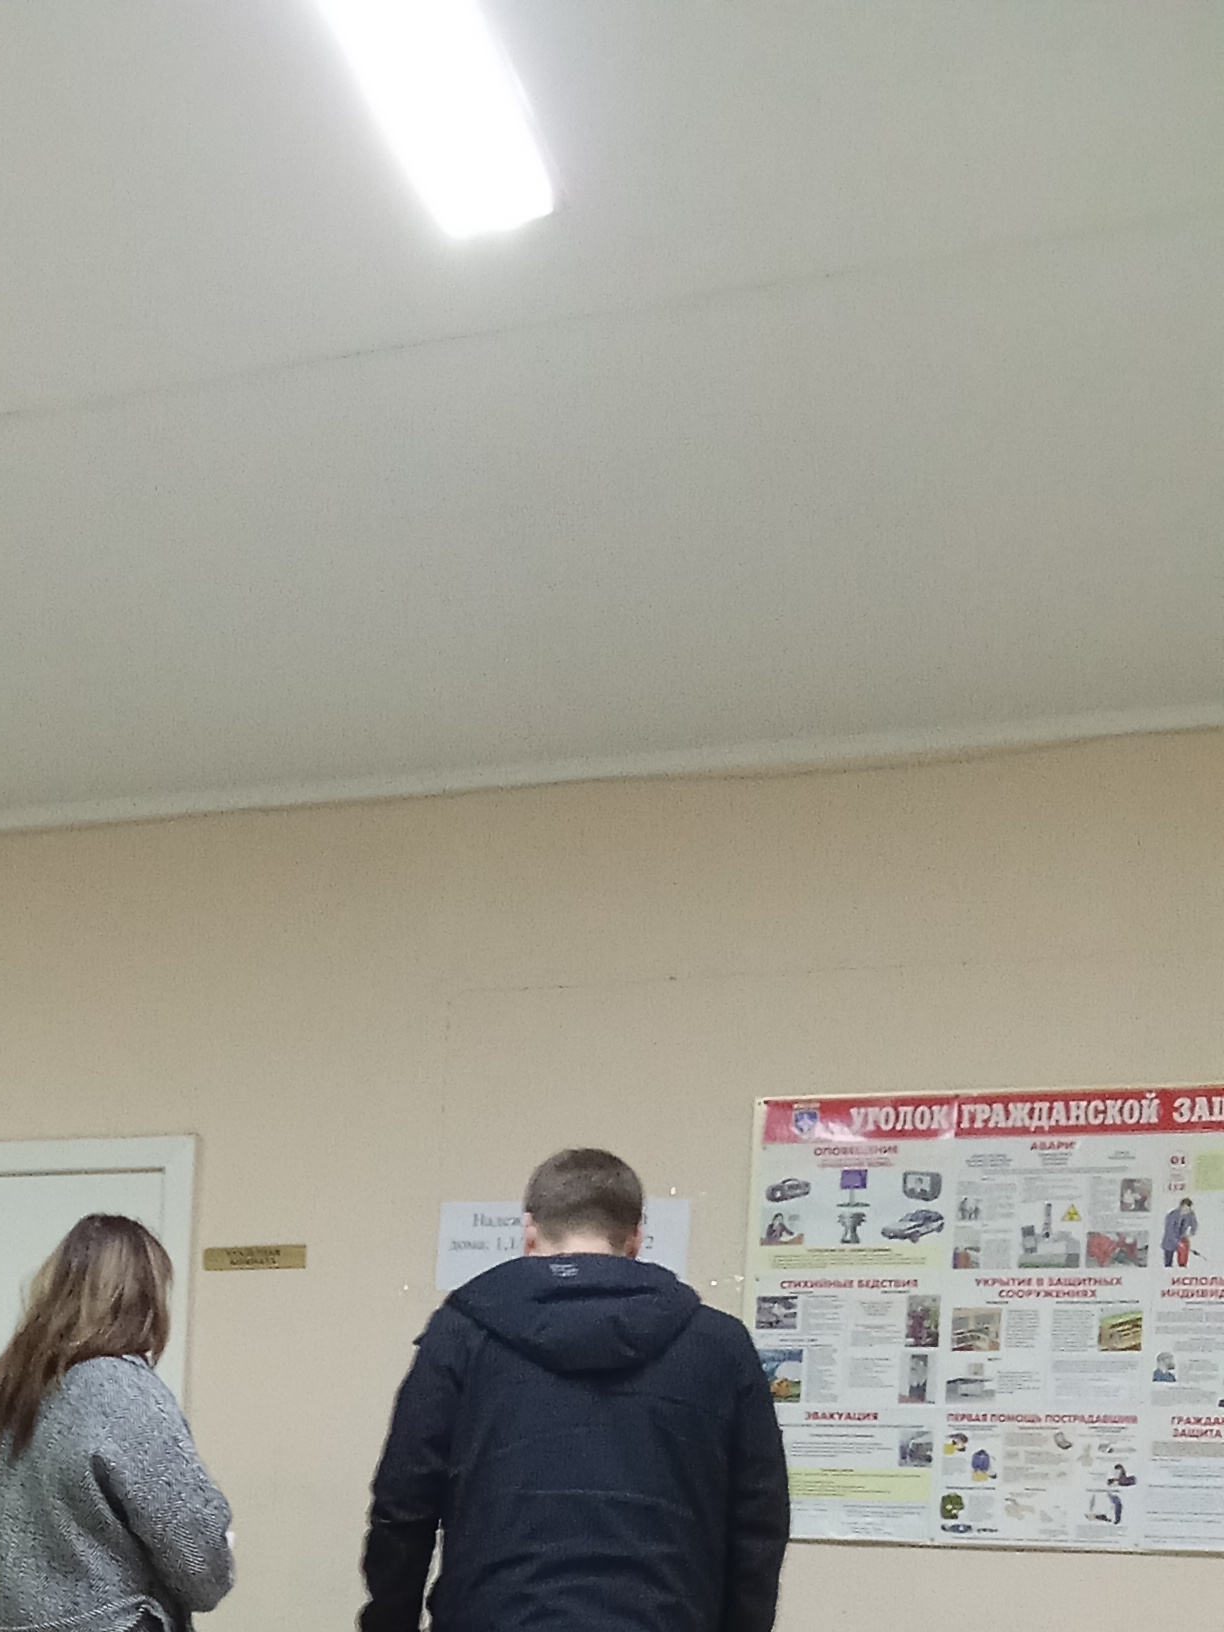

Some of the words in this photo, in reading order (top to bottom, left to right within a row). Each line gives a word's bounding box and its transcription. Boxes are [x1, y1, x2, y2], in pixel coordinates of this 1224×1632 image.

[850, 1105, 950, 1132] УГОЛОК
[960, 1092, 1160, 1131] ГРАЖДАНСКОЙ
[472, 1213, 523, 1228] Надеж
[857, 1279, 919, 1289] БЕДСТВИЯ
[975, 1277, 1033, 1287] УКРЫТИЕ
[1036, 1277, 1044, 1287] В
[1048, 1276, 1123, 1287] ЗАЩИТНЫХ
[998, 1289, 1097, 1299] СООРУЖЕНИЯХ
[804, 1411, 879, 1422] ЭВАКУАЦИЯ
[946, 1413, 988, 1423] ПЕРВАЯ
[990, 1413, 1042, 1424] ПОМОЩЬ
[1172, 1428, 1223, 1438] ЗАЩИТА
